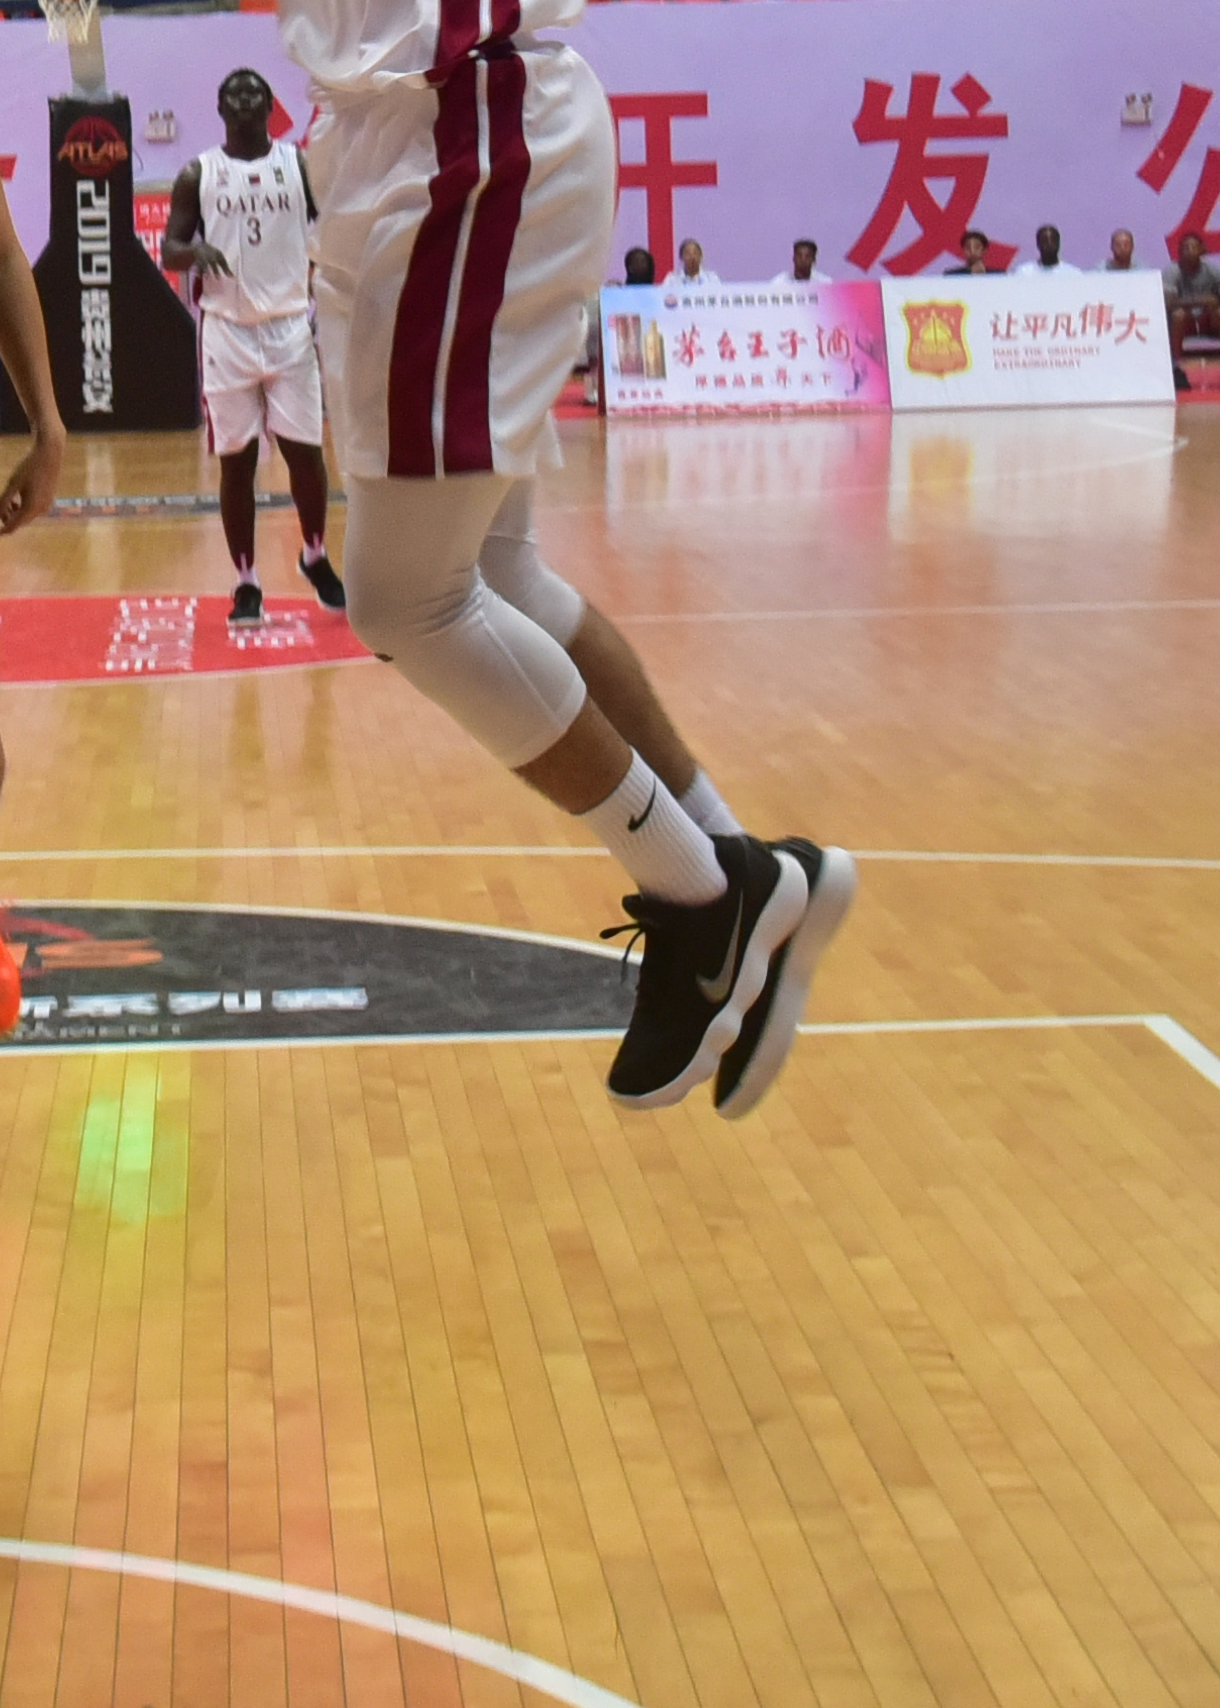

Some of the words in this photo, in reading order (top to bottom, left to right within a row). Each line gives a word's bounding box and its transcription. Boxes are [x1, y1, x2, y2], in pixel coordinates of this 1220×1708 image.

[216, 192, 291, 217] QATAR
[247, 216, 262, 246] 3
[990, 302, 1149, 345] 让平凡伟大
